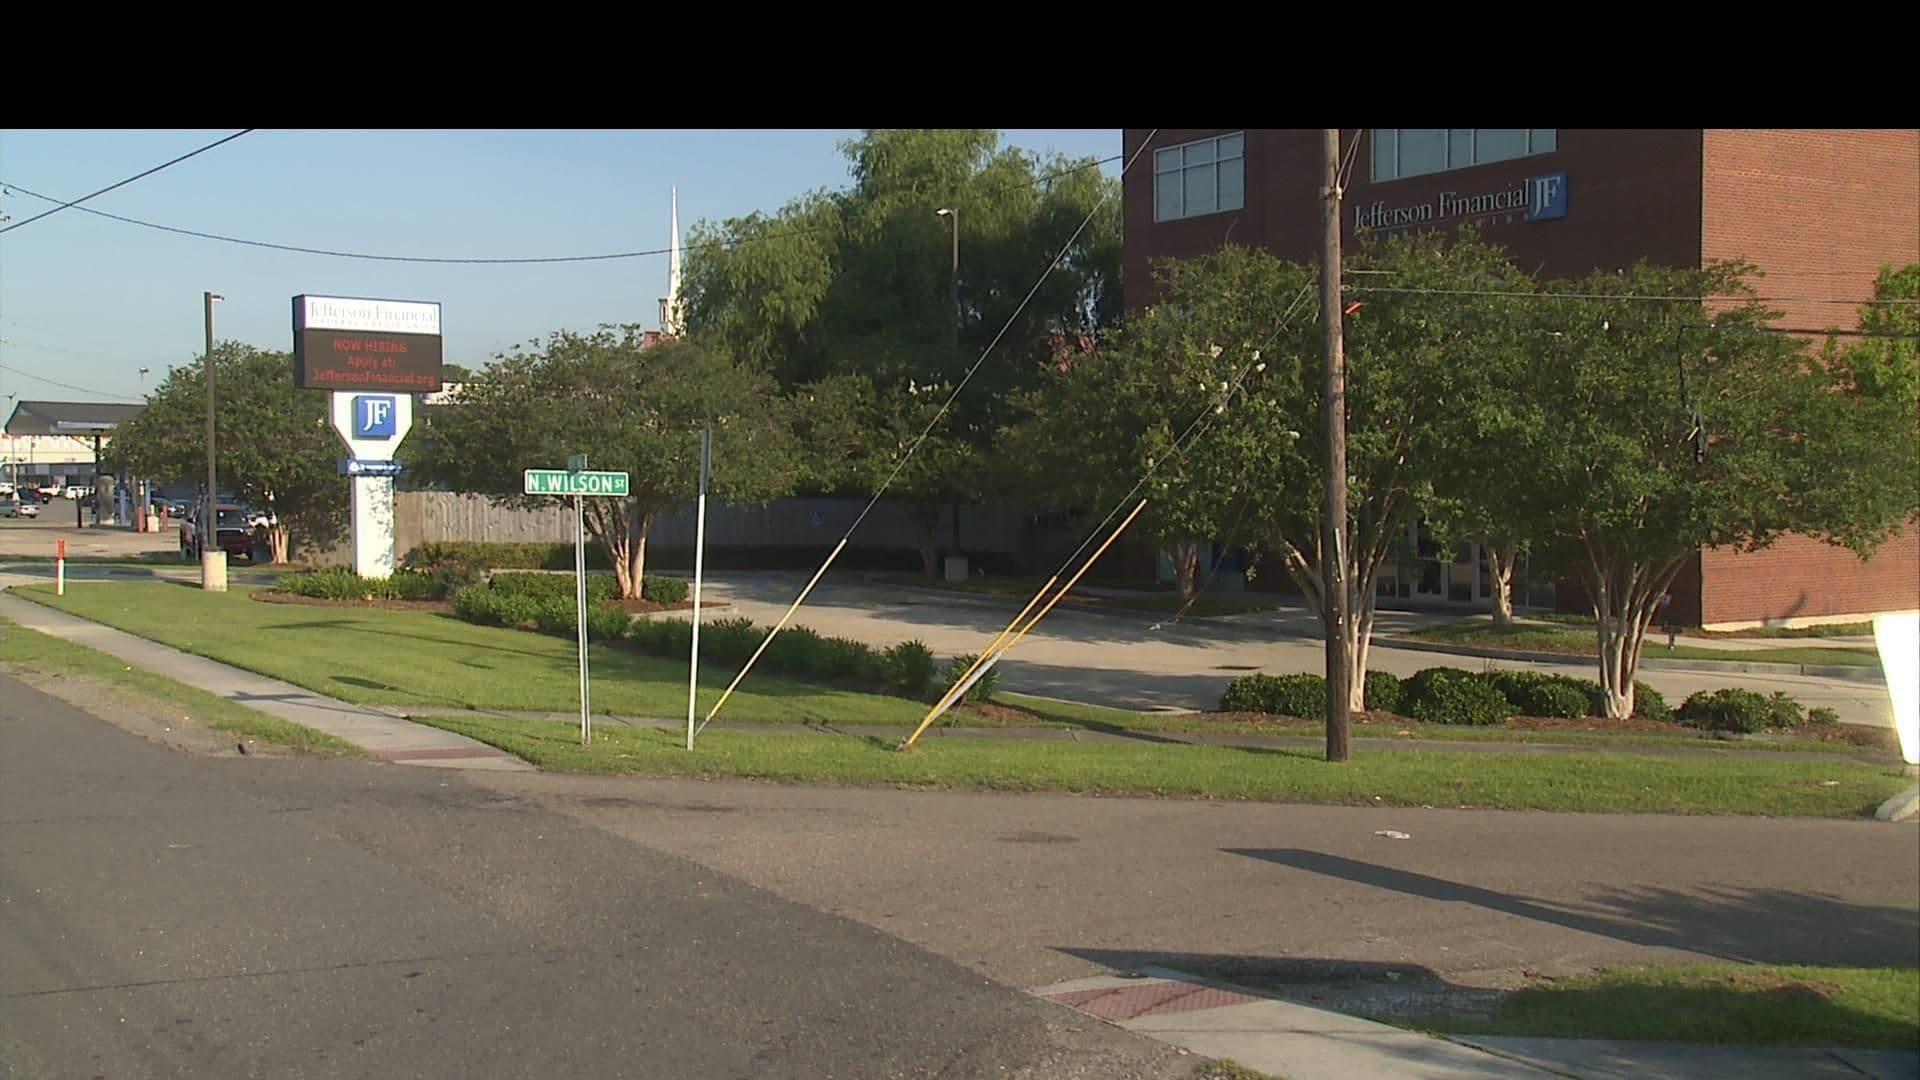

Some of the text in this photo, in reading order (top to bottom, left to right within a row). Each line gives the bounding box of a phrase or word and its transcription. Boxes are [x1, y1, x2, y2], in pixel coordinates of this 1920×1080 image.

[1354, 178, 1529, 228] Jefferson Financial
[1533, 176, 1561, 217] JF
[311, 301, 436, 323] Jefferson Financial
[334, 338, 408, 353] NOW HIRING
[347, 355, 378, 369] Apply
[313, 368, 435, 386] JeffersonFinancial.org
[363, 399, 391, 431] JF
[614, 478, 625, 489] ST
